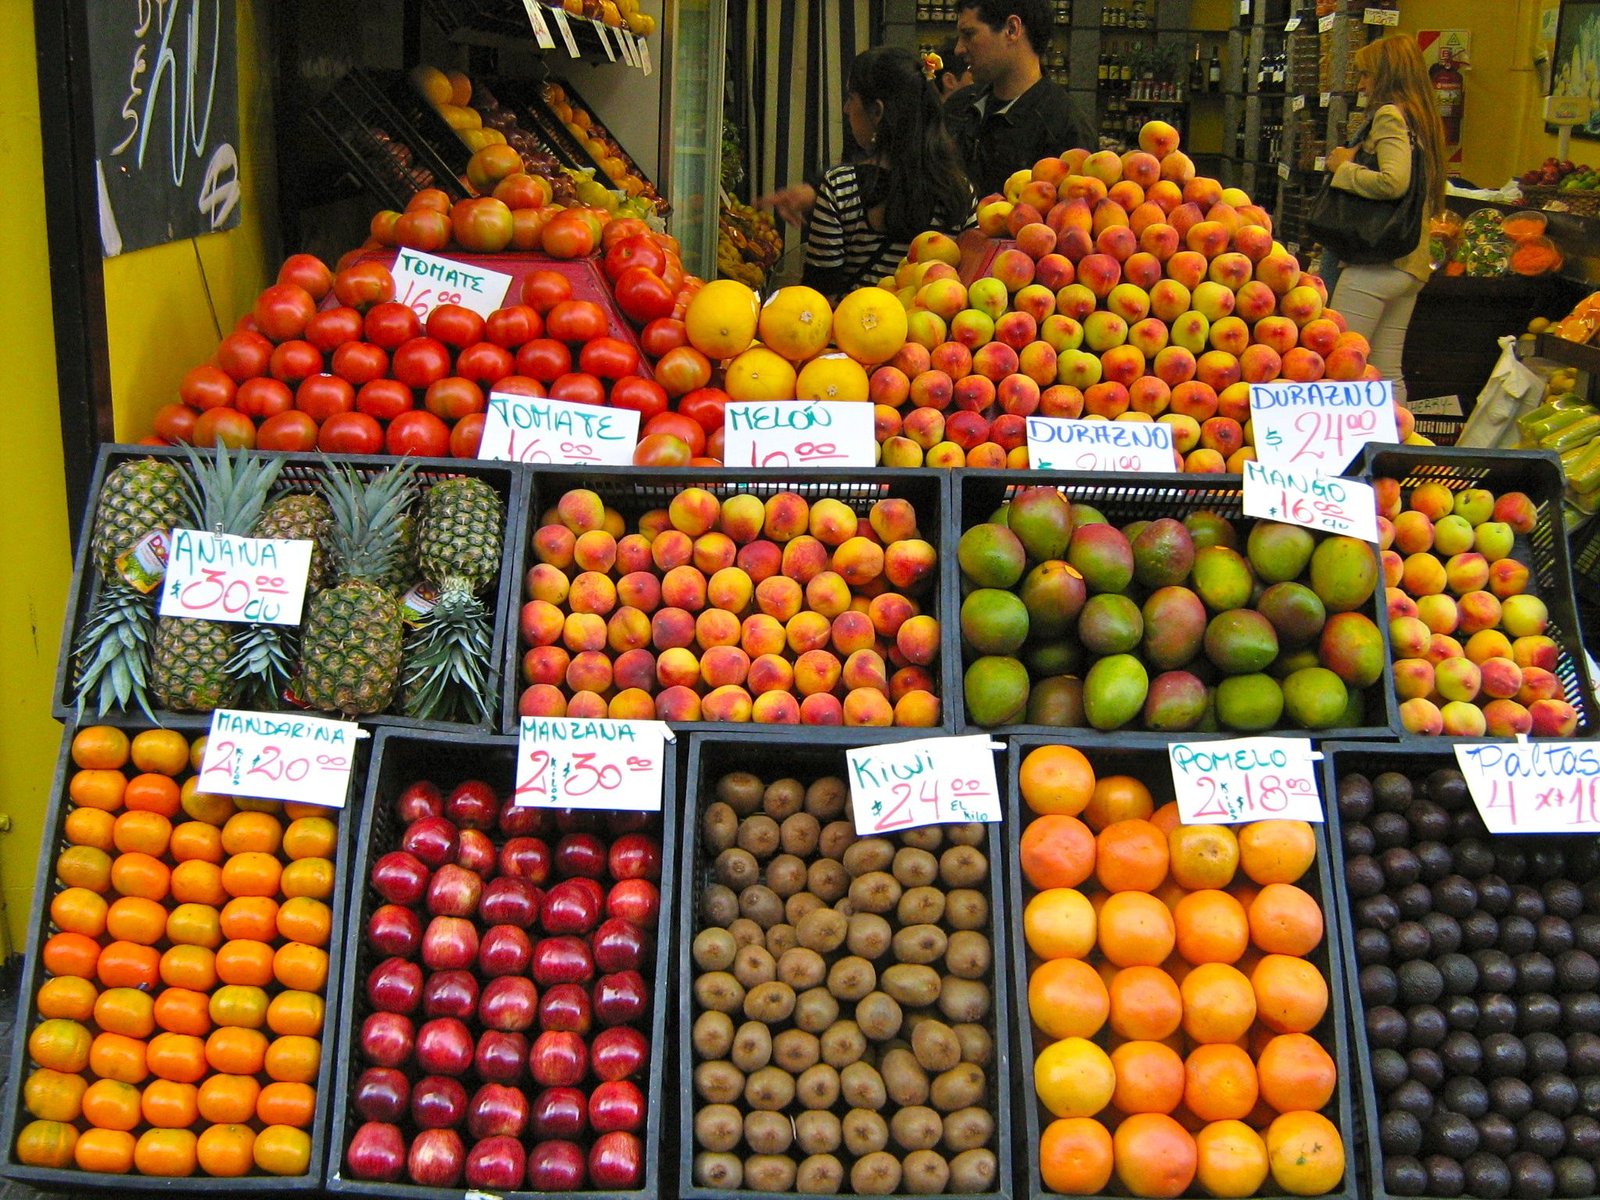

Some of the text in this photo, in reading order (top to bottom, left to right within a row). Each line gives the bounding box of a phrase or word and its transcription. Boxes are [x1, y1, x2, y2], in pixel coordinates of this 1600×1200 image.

[401, 253, 485, 293] TOMATE
[1252, 381, 1387, 409] DURAZNO
[490, 399, 626, 440] TOMATE
[1028, 420, 1170, 449] DURAZNO
[1247, 463, 1346, 502] MANGO
[522, 718, 637, 743] MANZANA
[1172, 744, 1287, 774] POMELO
[1465, 743, 1600, 777] Paltas
[1486, 780, 1517, 825] 4
